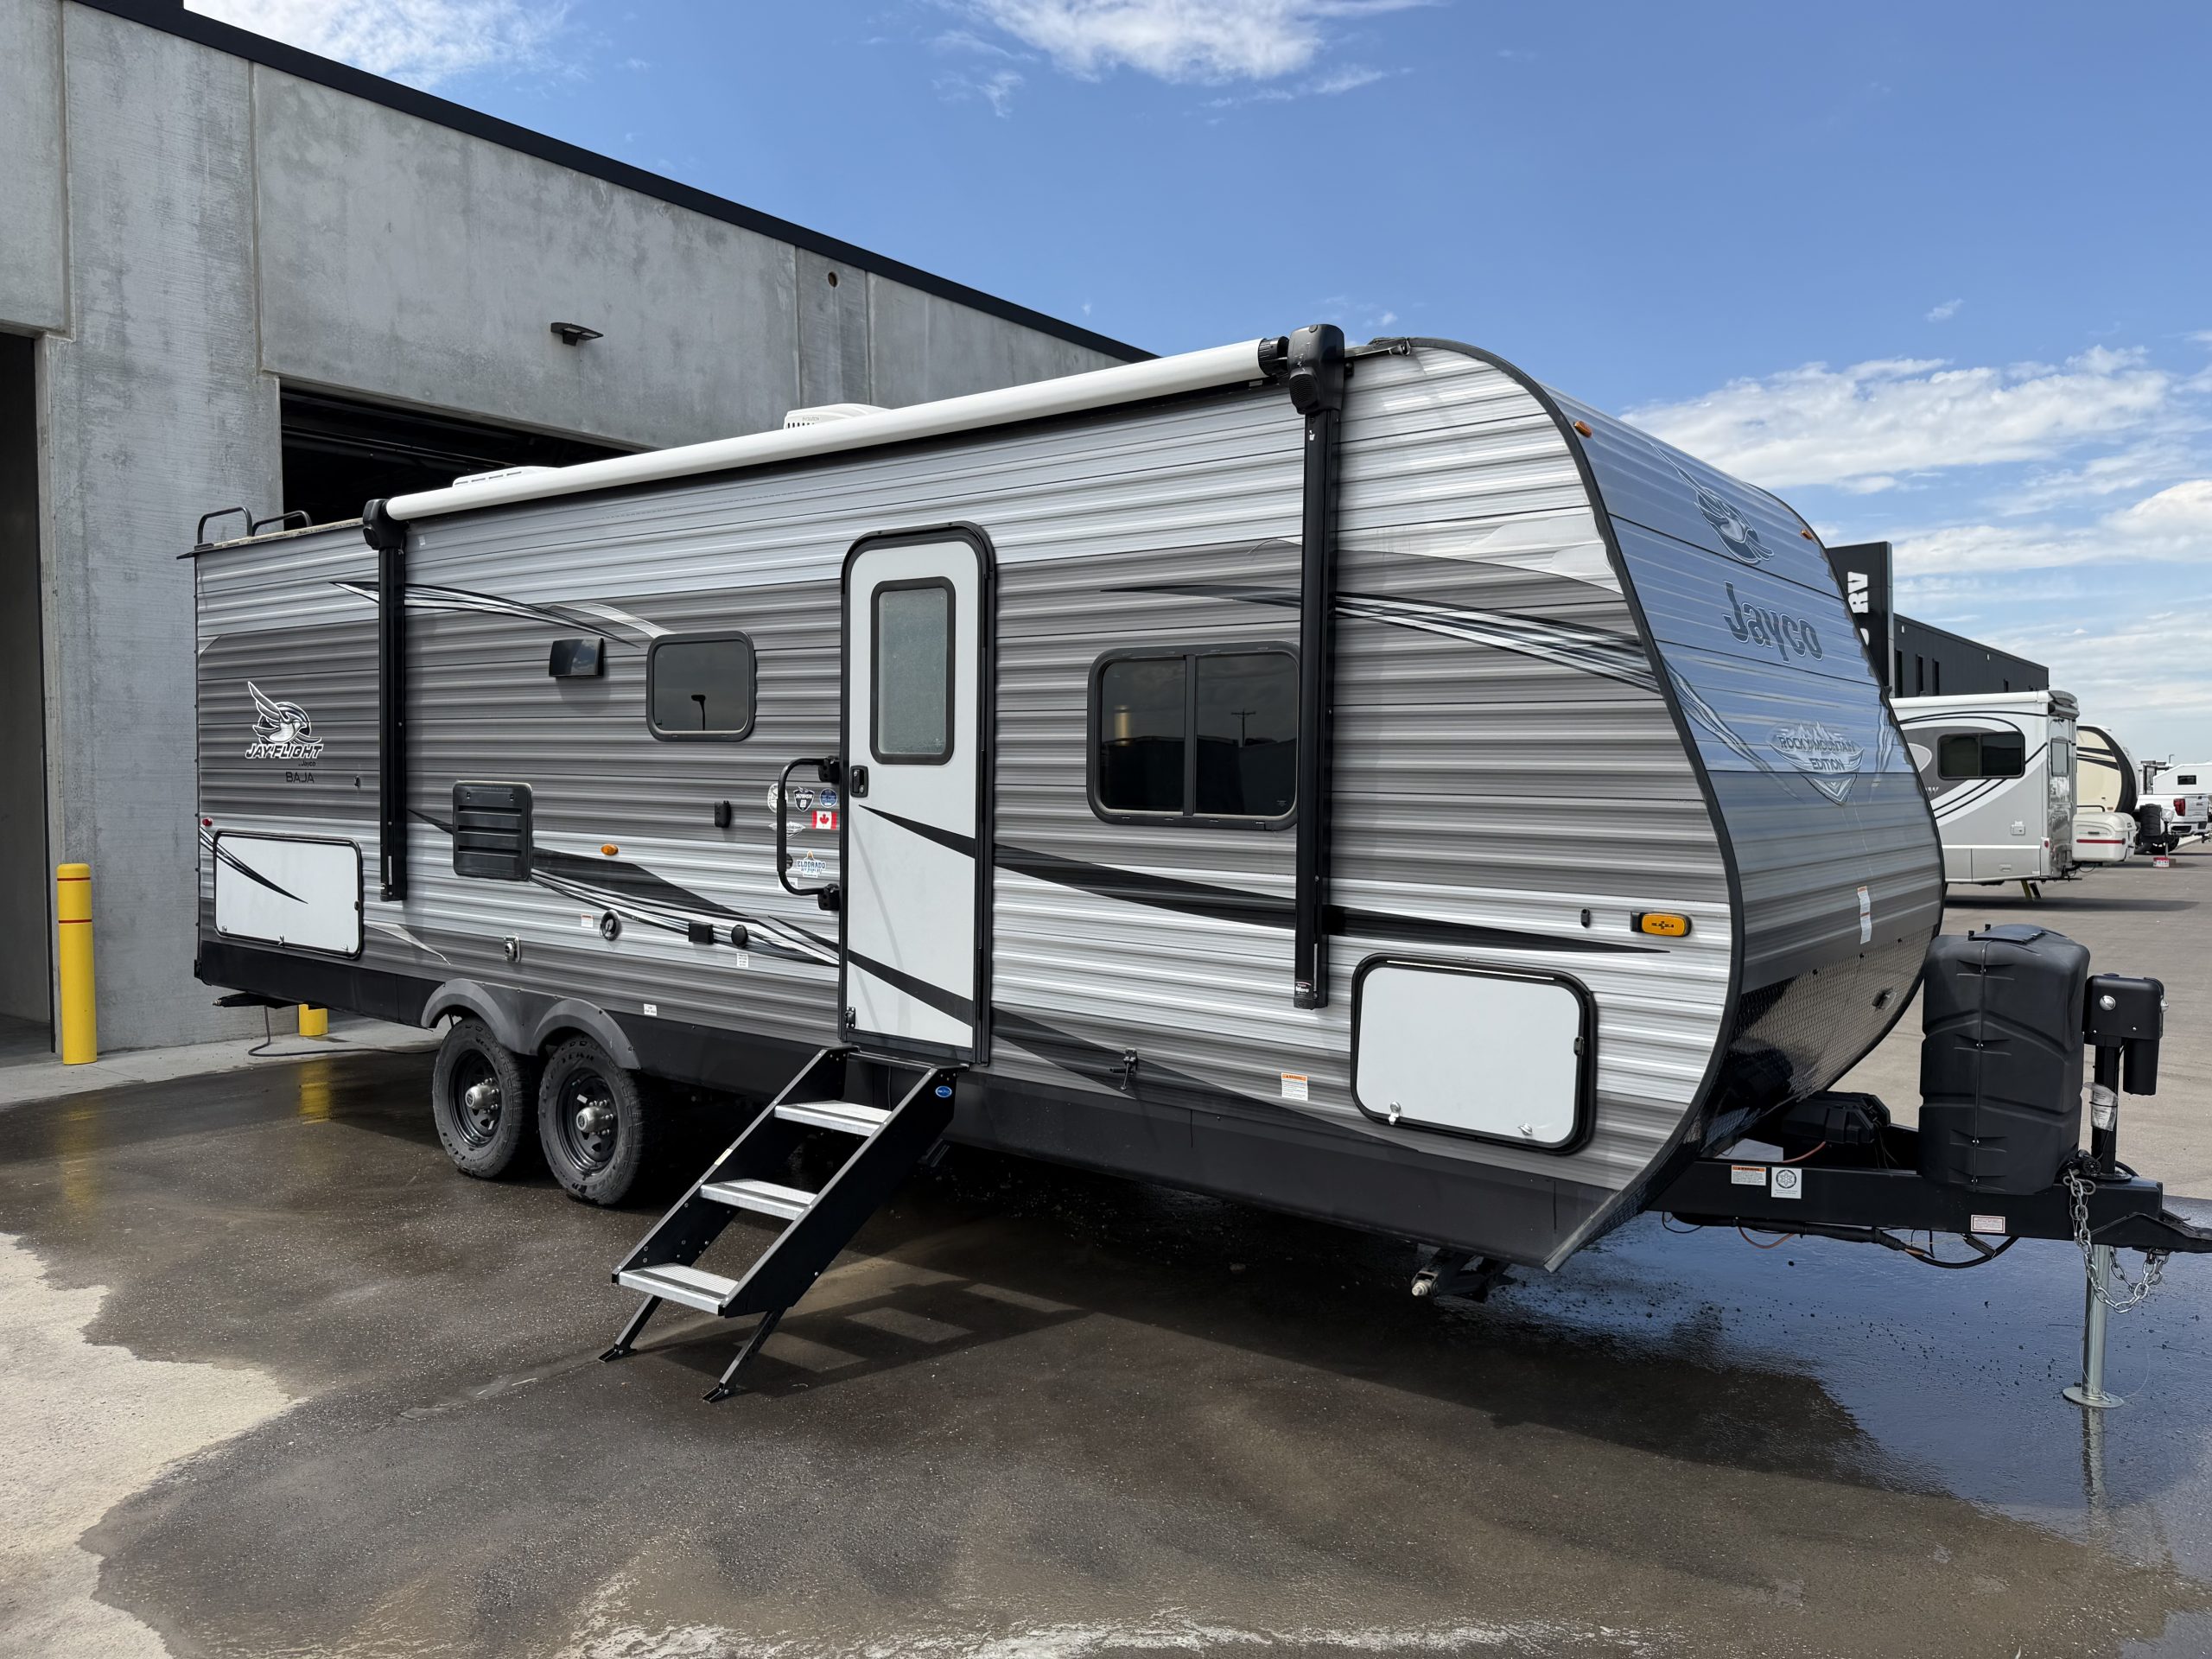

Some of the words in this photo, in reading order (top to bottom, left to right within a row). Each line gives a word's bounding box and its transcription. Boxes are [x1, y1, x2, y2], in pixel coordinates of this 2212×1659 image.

[1847, 572, 1868, 613] RV
[1721, 579, 1823, 664] Jayco
[1777, 736, 1812, 750] ROCKY
[1812, 738, 1856, 753] MOUNTAIN
[1808, 757, 1846, 771] EDITION
[285, 772, 315, 784] BAJA
[797, 861, 826, 869] ELDORADO
